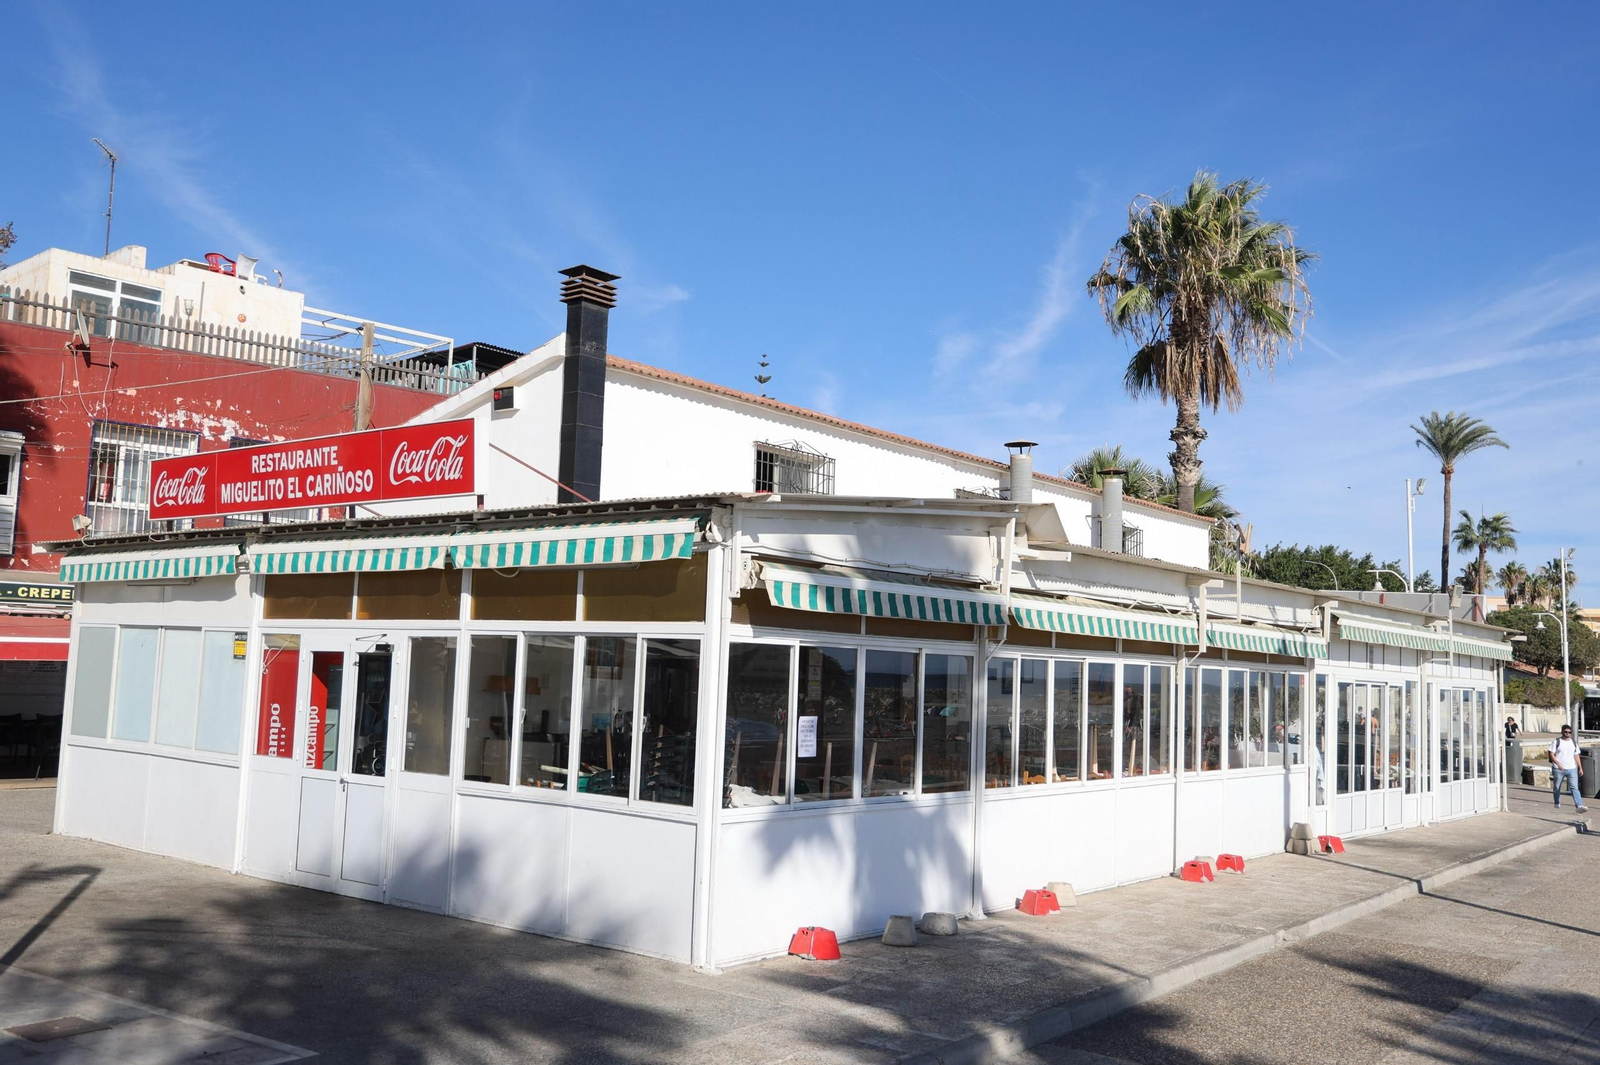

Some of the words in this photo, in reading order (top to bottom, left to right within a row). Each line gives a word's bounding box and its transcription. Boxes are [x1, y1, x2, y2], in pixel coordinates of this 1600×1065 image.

[252, 446, 338, 474] RESTAURANTE
[389, 434, 468, 486] Coca-Cola
[153, 466, 209, 508] Coca-Cola
[221, 479, 284, 504] MIGUELITO
[288, 479, 303, 499] EL
[306, 466, 374, 497] CARIÑOSO
